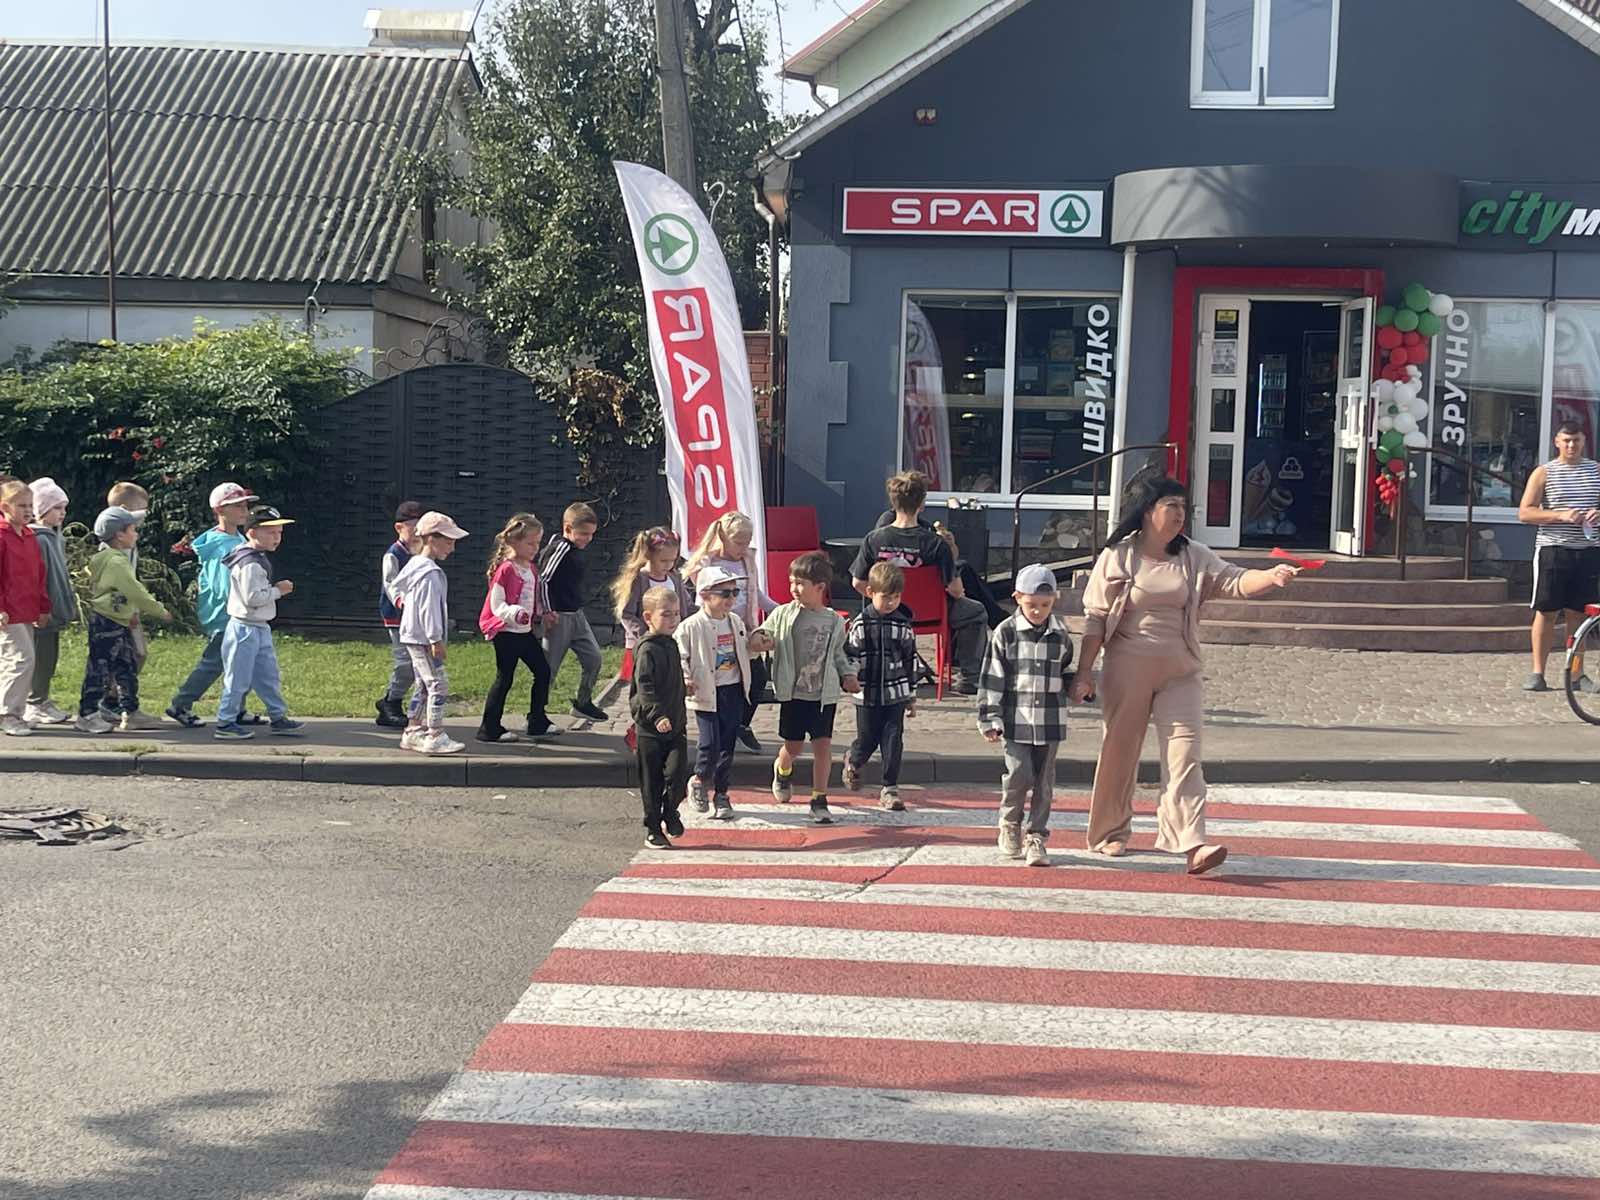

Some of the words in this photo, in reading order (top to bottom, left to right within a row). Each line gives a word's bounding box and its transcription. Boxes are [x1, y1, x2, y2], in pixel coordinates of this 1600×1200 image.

[891, 198, 1035, 225] SPAR
[1082, 304, 1112, 454] ШВИДКО
[1442, 309, 1470, 446] ЗРУЧНО
